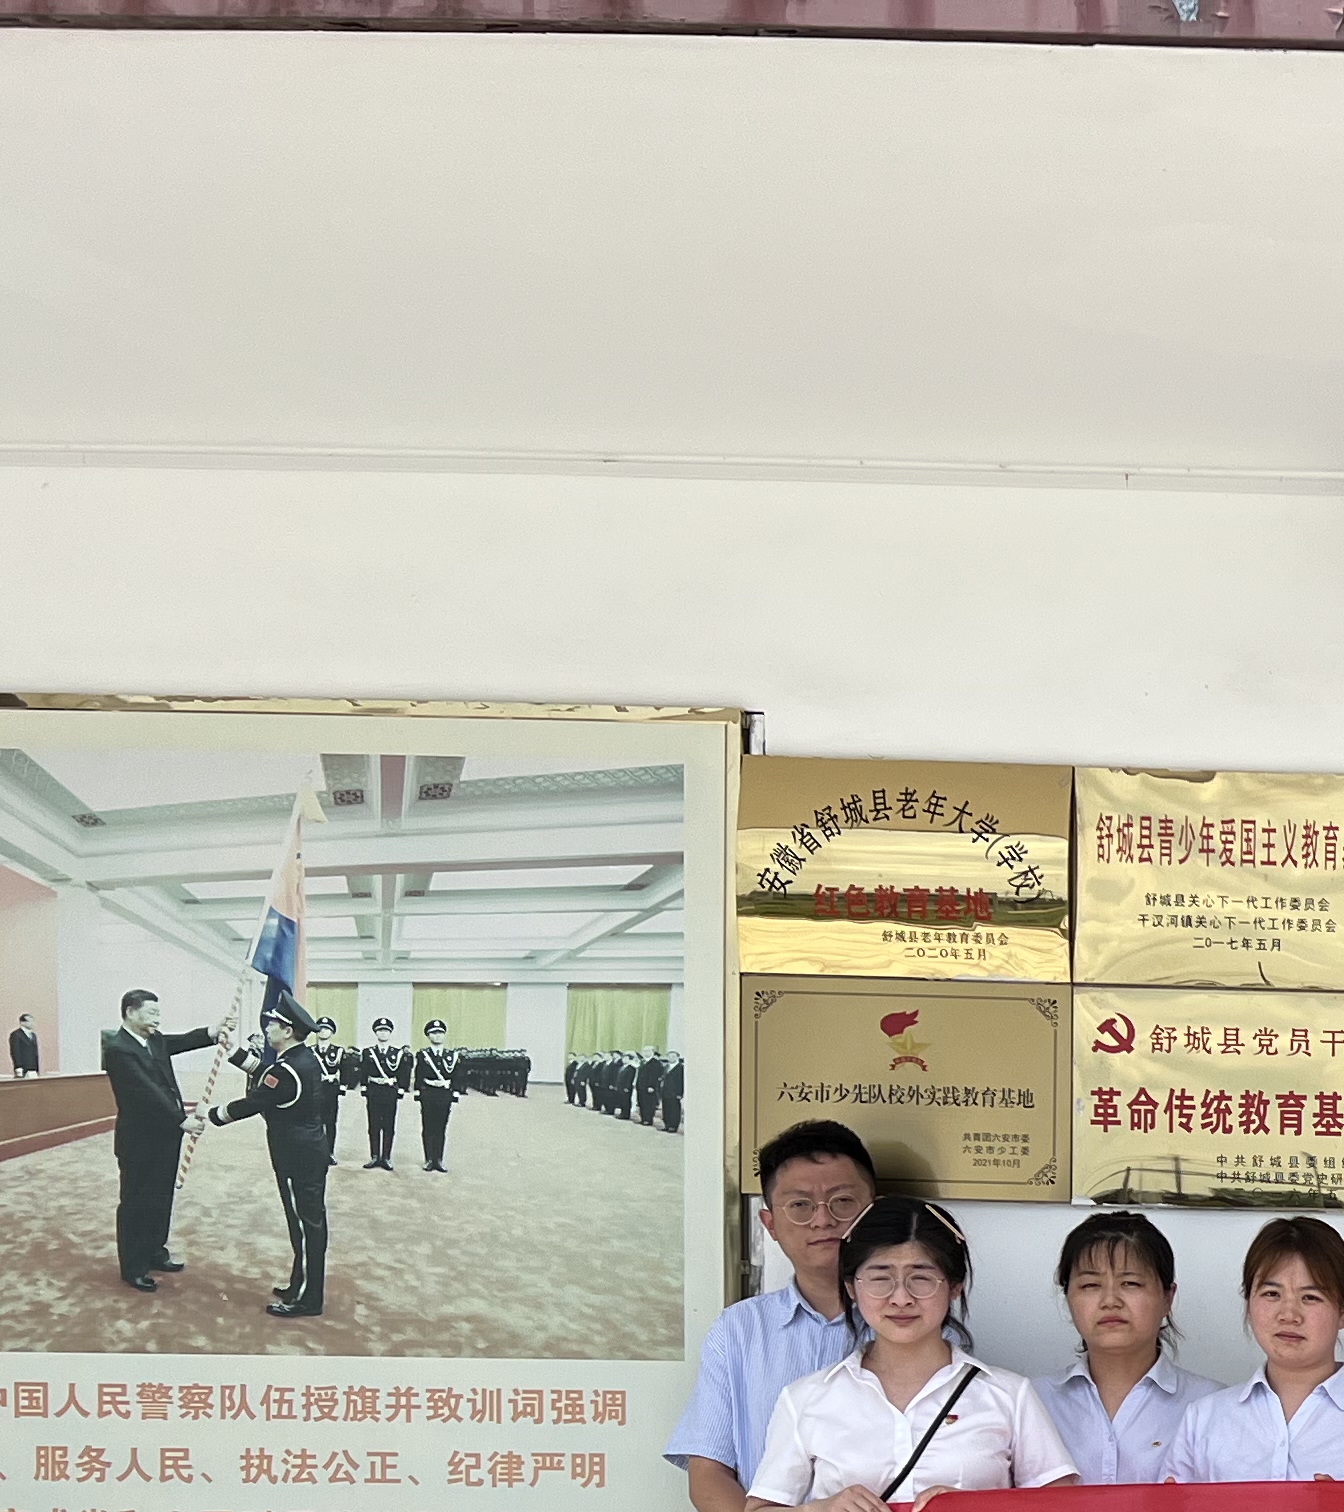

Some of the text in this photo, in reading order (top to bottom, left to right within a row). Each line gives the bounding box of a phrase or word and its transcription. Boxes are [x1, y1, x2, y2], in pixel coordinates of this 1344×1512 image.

[813, 884, 993, 921] 红色教育基地
[1145, 892, 1330, 912] 舒城县关心下一代工作委员会
[776, 1082, 1036, 1109] 六安市少先队校外实践教育基地
[972, 1158, 1021, 1168] 2021年10月
[0, 1382, 627, 1426] 国人民警察队伍授旗并致训词强调
